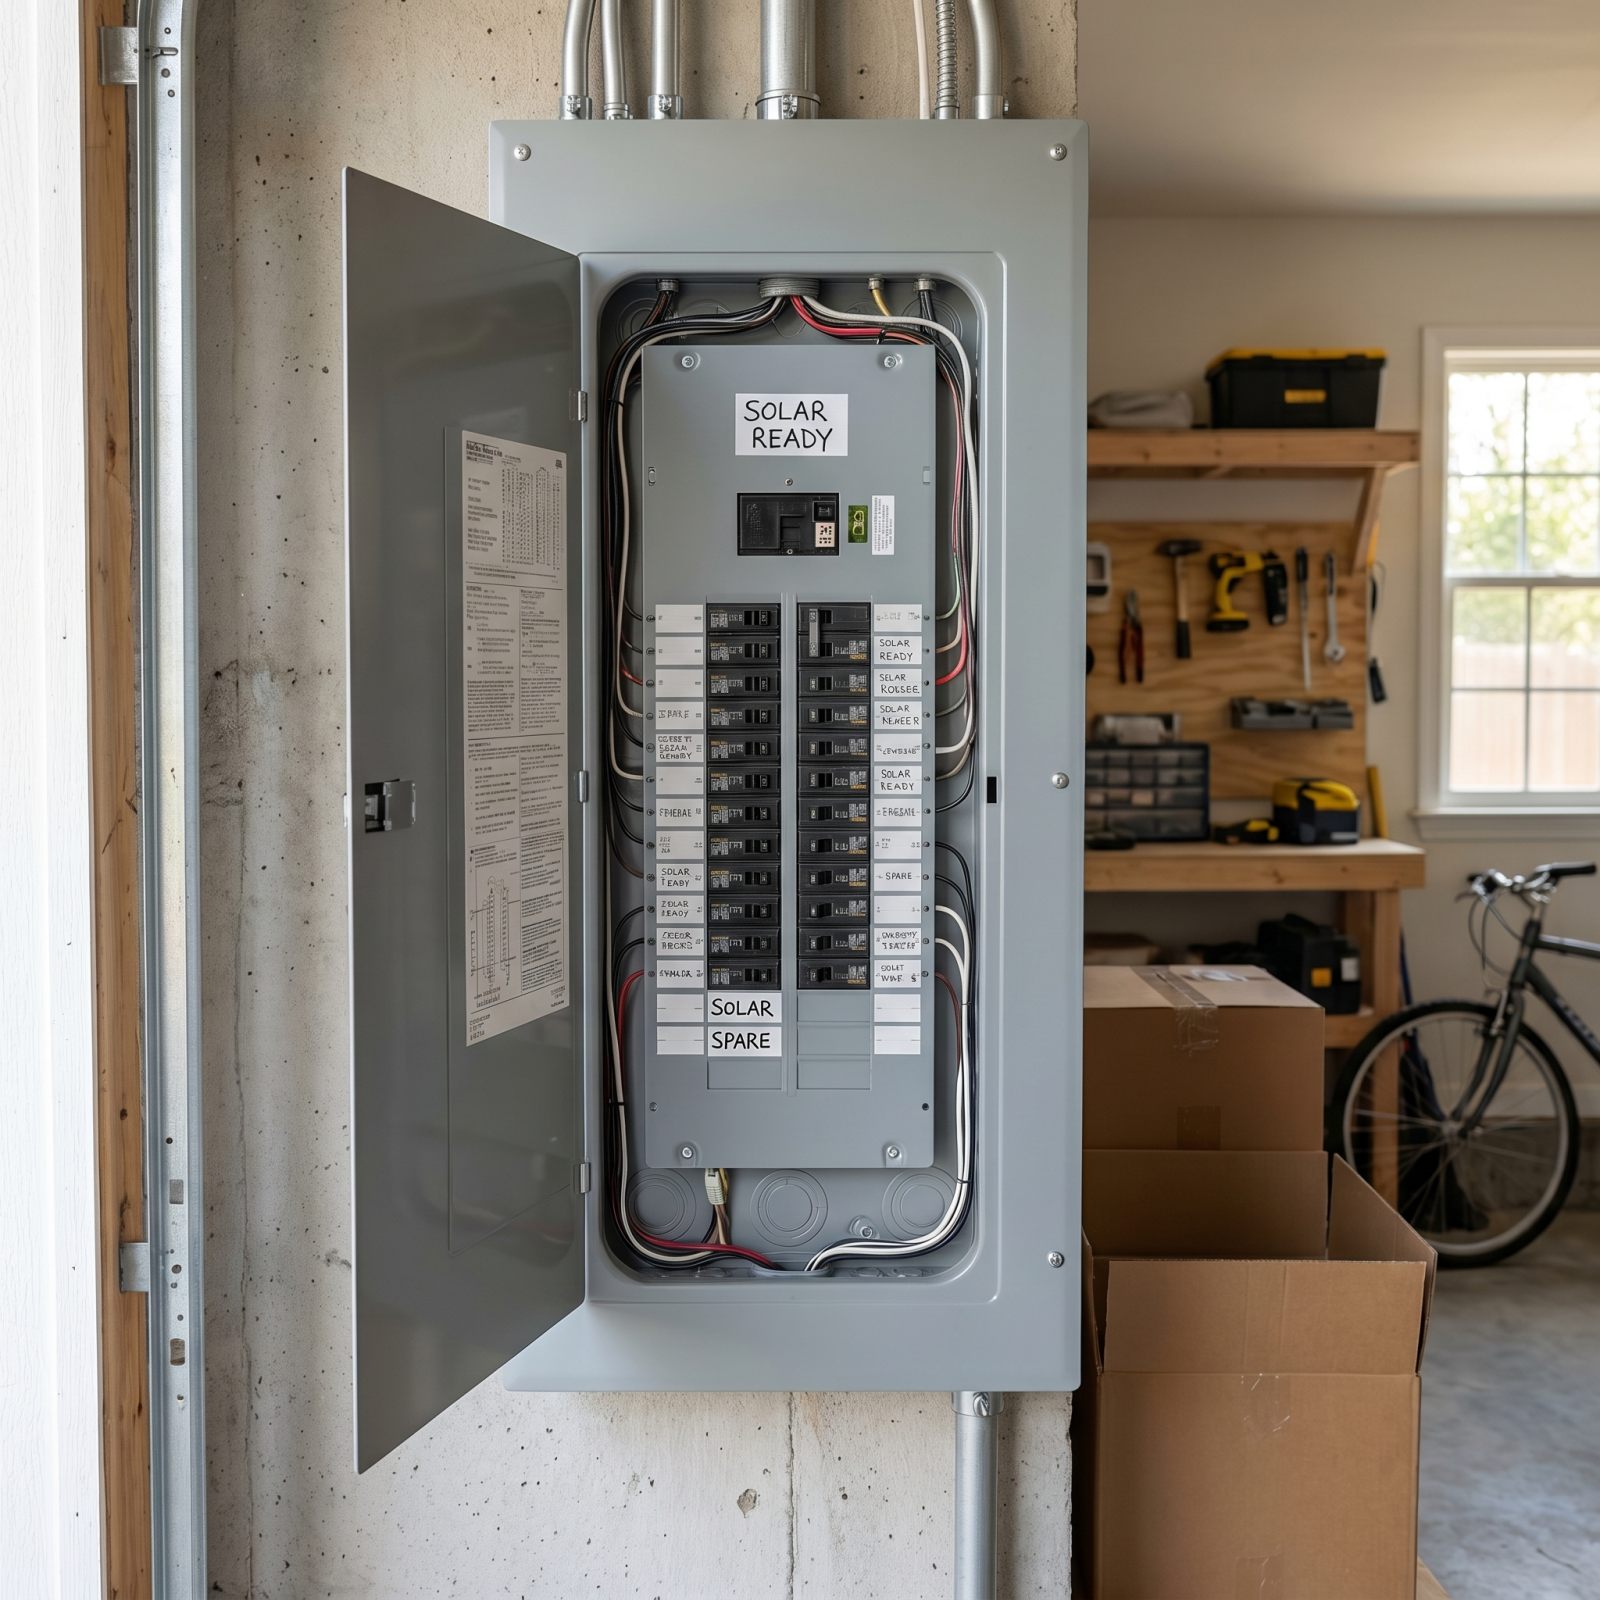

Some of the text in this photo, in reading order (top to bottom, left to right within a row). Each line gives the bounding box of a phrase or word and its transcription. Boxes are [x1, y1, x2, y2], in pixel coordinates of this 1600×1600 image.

[744, 400, 827, 421] SOLAR
[753, 427, 832, 452] READY
[879, 638, 911, 648] SOLAR
[879, 651, 913, 663] READY
[880, 768, 911, 779] SOLAR
[880, 781, 915, 791] READY
[885, 871, 913, 881] SPARE
[711, 998, 773, 1017] SOLAR
[712, 1032, 770, 1049] SPARE
